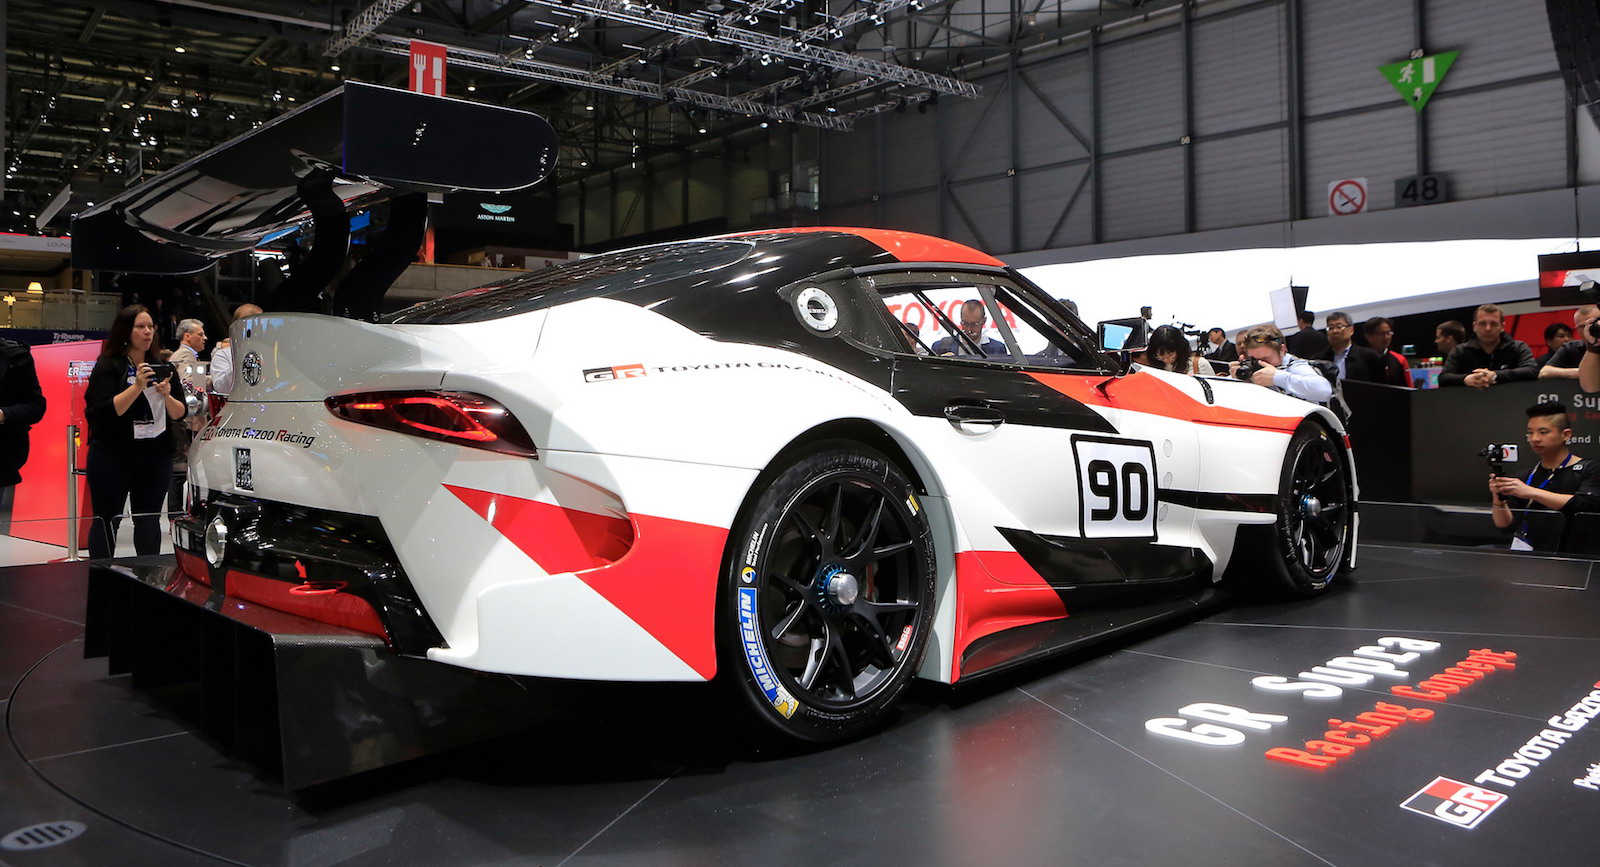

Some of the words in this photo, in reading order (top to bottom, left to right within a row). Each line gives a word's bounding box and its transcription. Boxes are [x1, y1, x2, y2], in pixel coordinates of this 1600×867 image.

[1402, 177, 1439, 201] 48
[582, 363, 648, 383] GR
[275, 429, 315, 448] Racing
[1087, 459, 1149, 521] 90
[740, 591, 776, 692] MICHELIN
[1145, 702, 1289, 746] GR
[1251, 636, 1442, 700] Supra
[1265, 701, 1436, 771] Racing
[1391, 648, 1518, 701] Concept
[1474, 729, 1573, 787] TOYOTA
